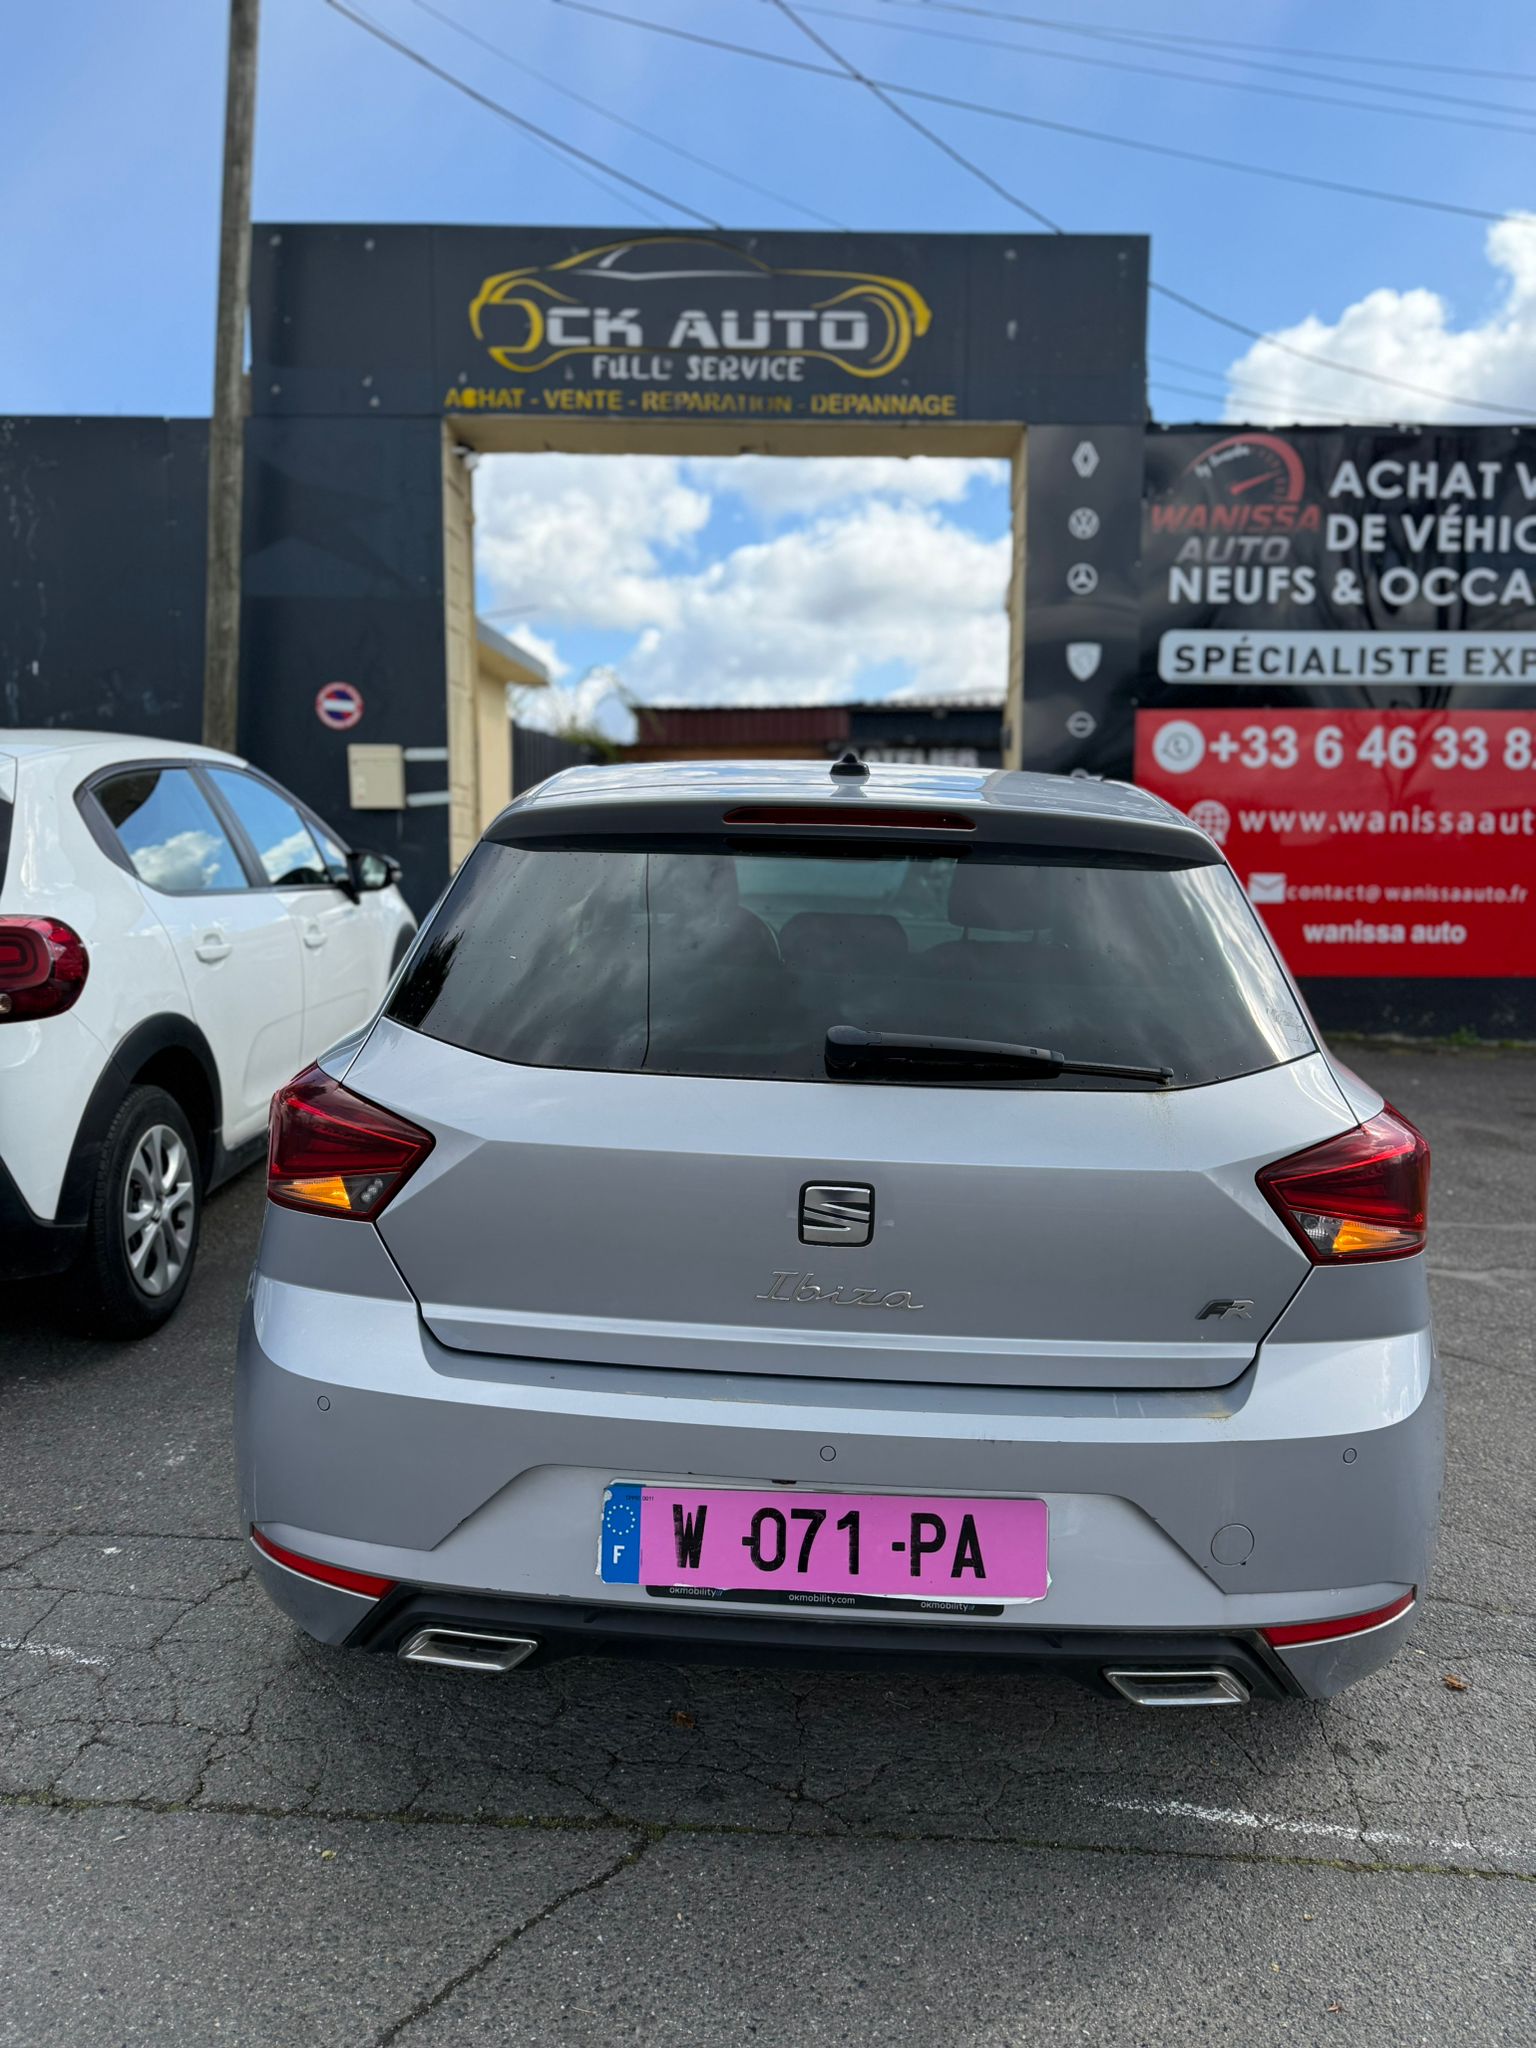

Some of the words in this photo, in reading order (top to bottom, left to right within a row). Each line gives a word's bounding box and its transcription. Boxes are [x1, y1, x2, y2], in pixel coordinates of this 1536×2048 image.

[668, 310, 869, 350] AUTO
[593, 356, 667, 380] FULL
[686, 357, 804, 382] SERVICE
[543, 388, 623, 411] VENTE
[811, 394, 957, 416] DEPANNAGE
[1329, 460, 1502, 499] ACHAT
[1150, 504, 1321, 533] WANISSA
[1326, 515, 1386, 552] DE
[1402, 505, 1536, 553] VÉHIC
[1176, 536, 1291, 563] AUTO
[1168, 566, 1317, 604] NEUFS
[1331, 571, 1363, 605] &
[1380, 567, 1535, 606] OCCA
[1174, 636, 1449, 677] SPÉCIALISTE
[1463, 647, 1536, 677] EXP
[1209, 725, 1300, 769] +33
[1314, 725, 1344, 769] 6
[1357, 725, 1417, 769] 46
[1431, 726, 1489, 770] 33
[1503, 727, 1536, 771] 8
[1238, 805, 1536, 836] www.wanissaaut
[1302, 919, 1405, 944] wanissa
[1410, 921, 1467, 944] auto
[756, 1270, 924, 1309] Ibiza
[1199, 1299, 1255, 1320] FR
[613, 1545, 625, 1564] F
[669, 1586, 716, 1597] okmobility
[788, 1593, 855, 1605] okmobility.com
[920, 1600, 968, 1611] okmobility
